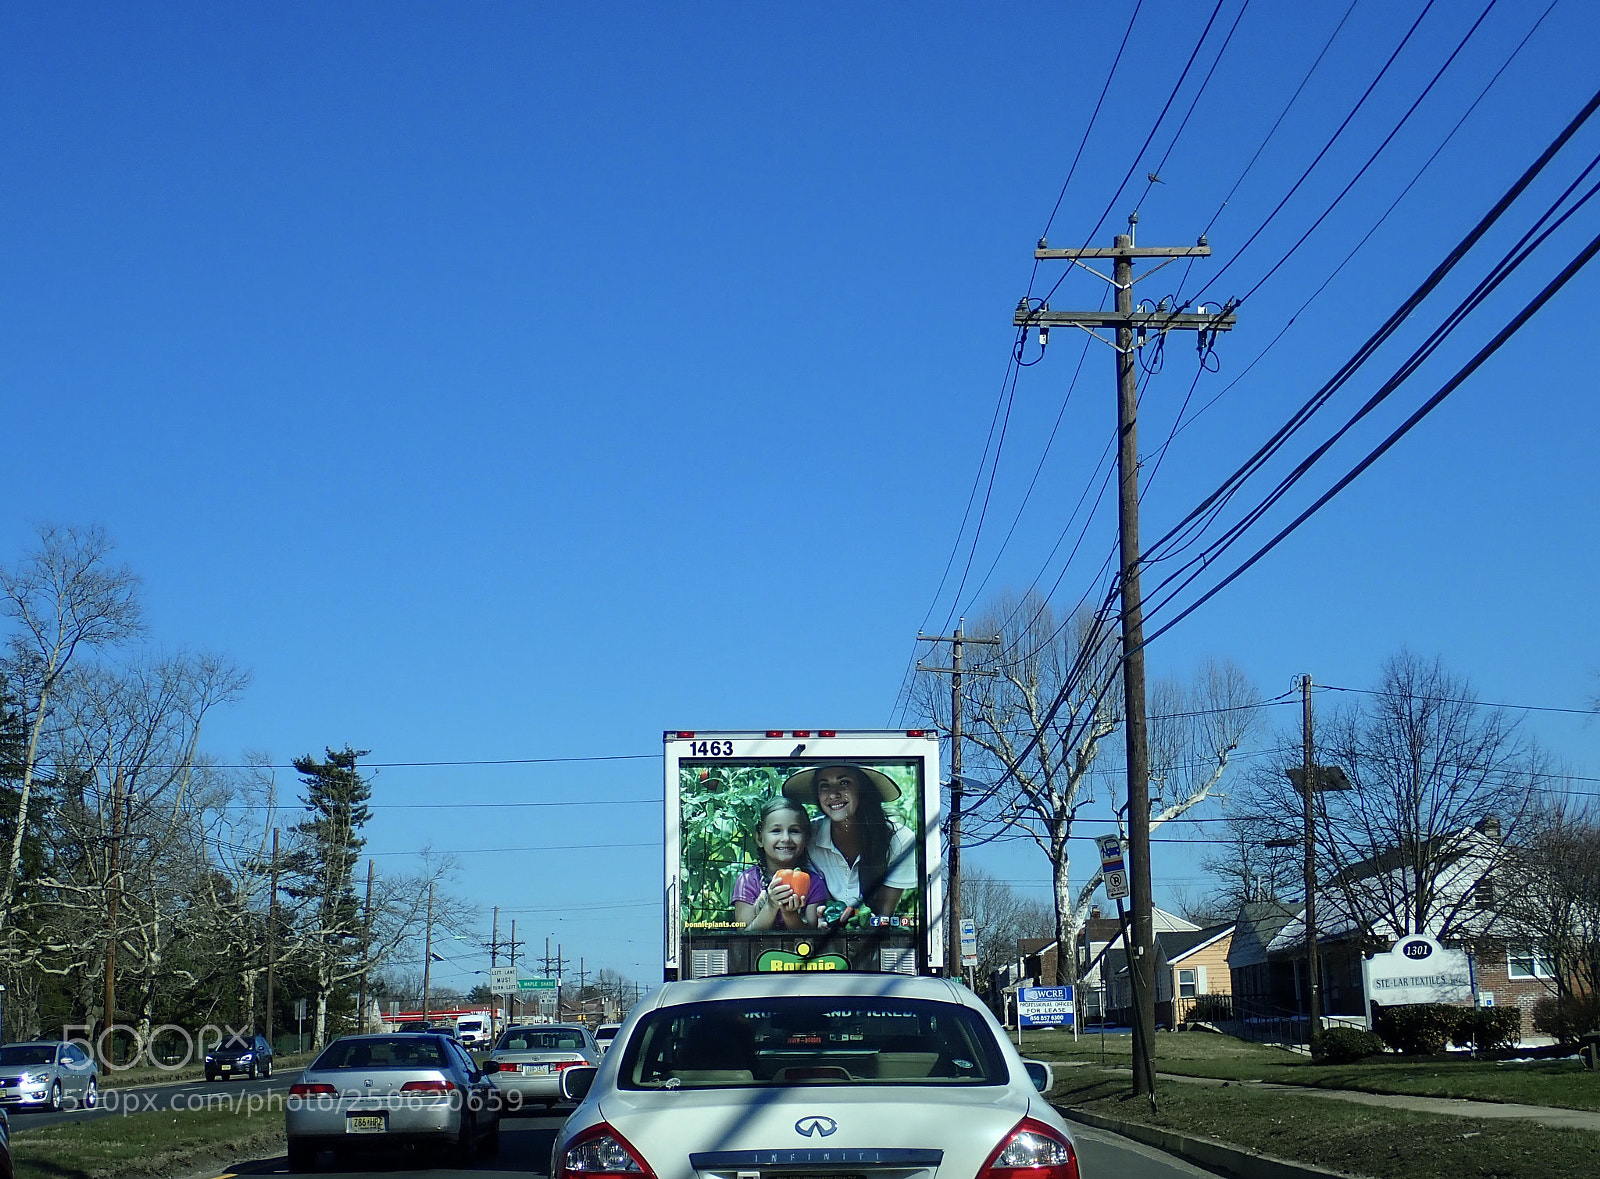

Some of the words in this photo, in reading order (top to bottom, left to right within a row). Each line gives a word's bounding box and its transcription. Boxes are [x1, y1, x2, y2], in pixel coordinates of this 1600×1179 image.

[690, 741, 733, 756] 1463
[685, 921, 746, 930] bonnieplants.com
[1406, 945, 1428, 956] 1301
[771, 960, 836, 971] Bonnie
[1409, 975, 1446, 987] TEXTILES
[1037, 990, 1064, 998] WCRE
[755, 1152, 880, 1163] INFINITI
